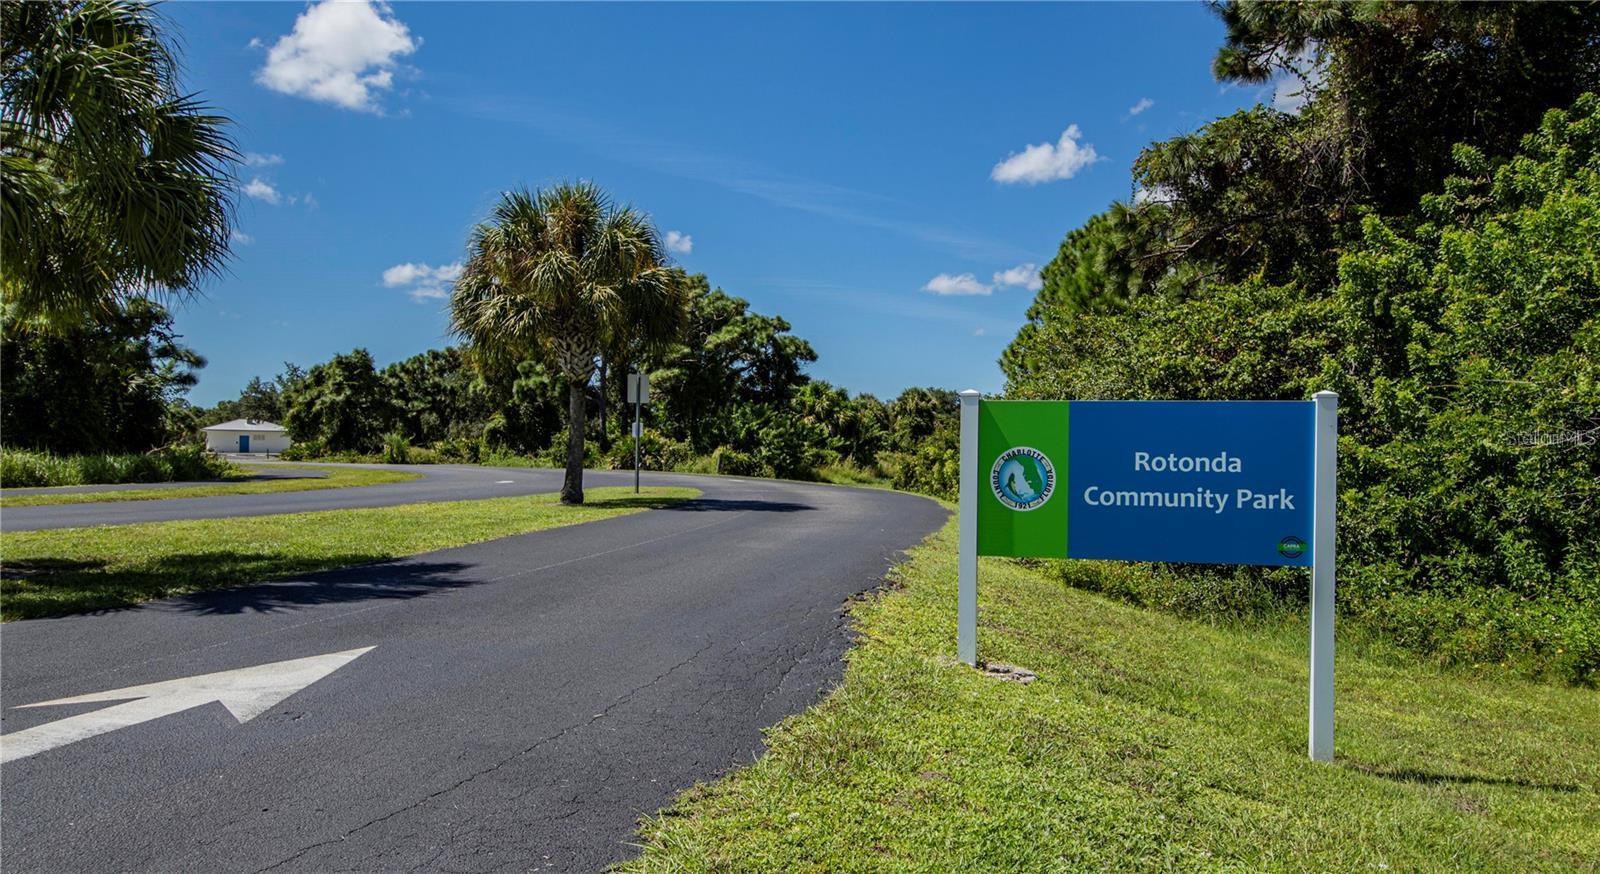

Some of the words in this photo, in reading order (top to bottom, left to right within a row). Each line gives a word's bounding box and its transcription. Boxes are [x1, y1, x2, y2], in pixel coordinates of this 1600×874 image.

[1001, 449, 1044, 461] CHARLOTTE
[1134, 452, 1242, 473] Rotonda
[992, 470, 1004, 499] COUNTY
[1039, 468, 1054, 501] FLORIDA
[1014, 502, 1031, 510] 1921
[1083, 486, 1229, 514] Community
[1236, 488, 1295, 510] Park
